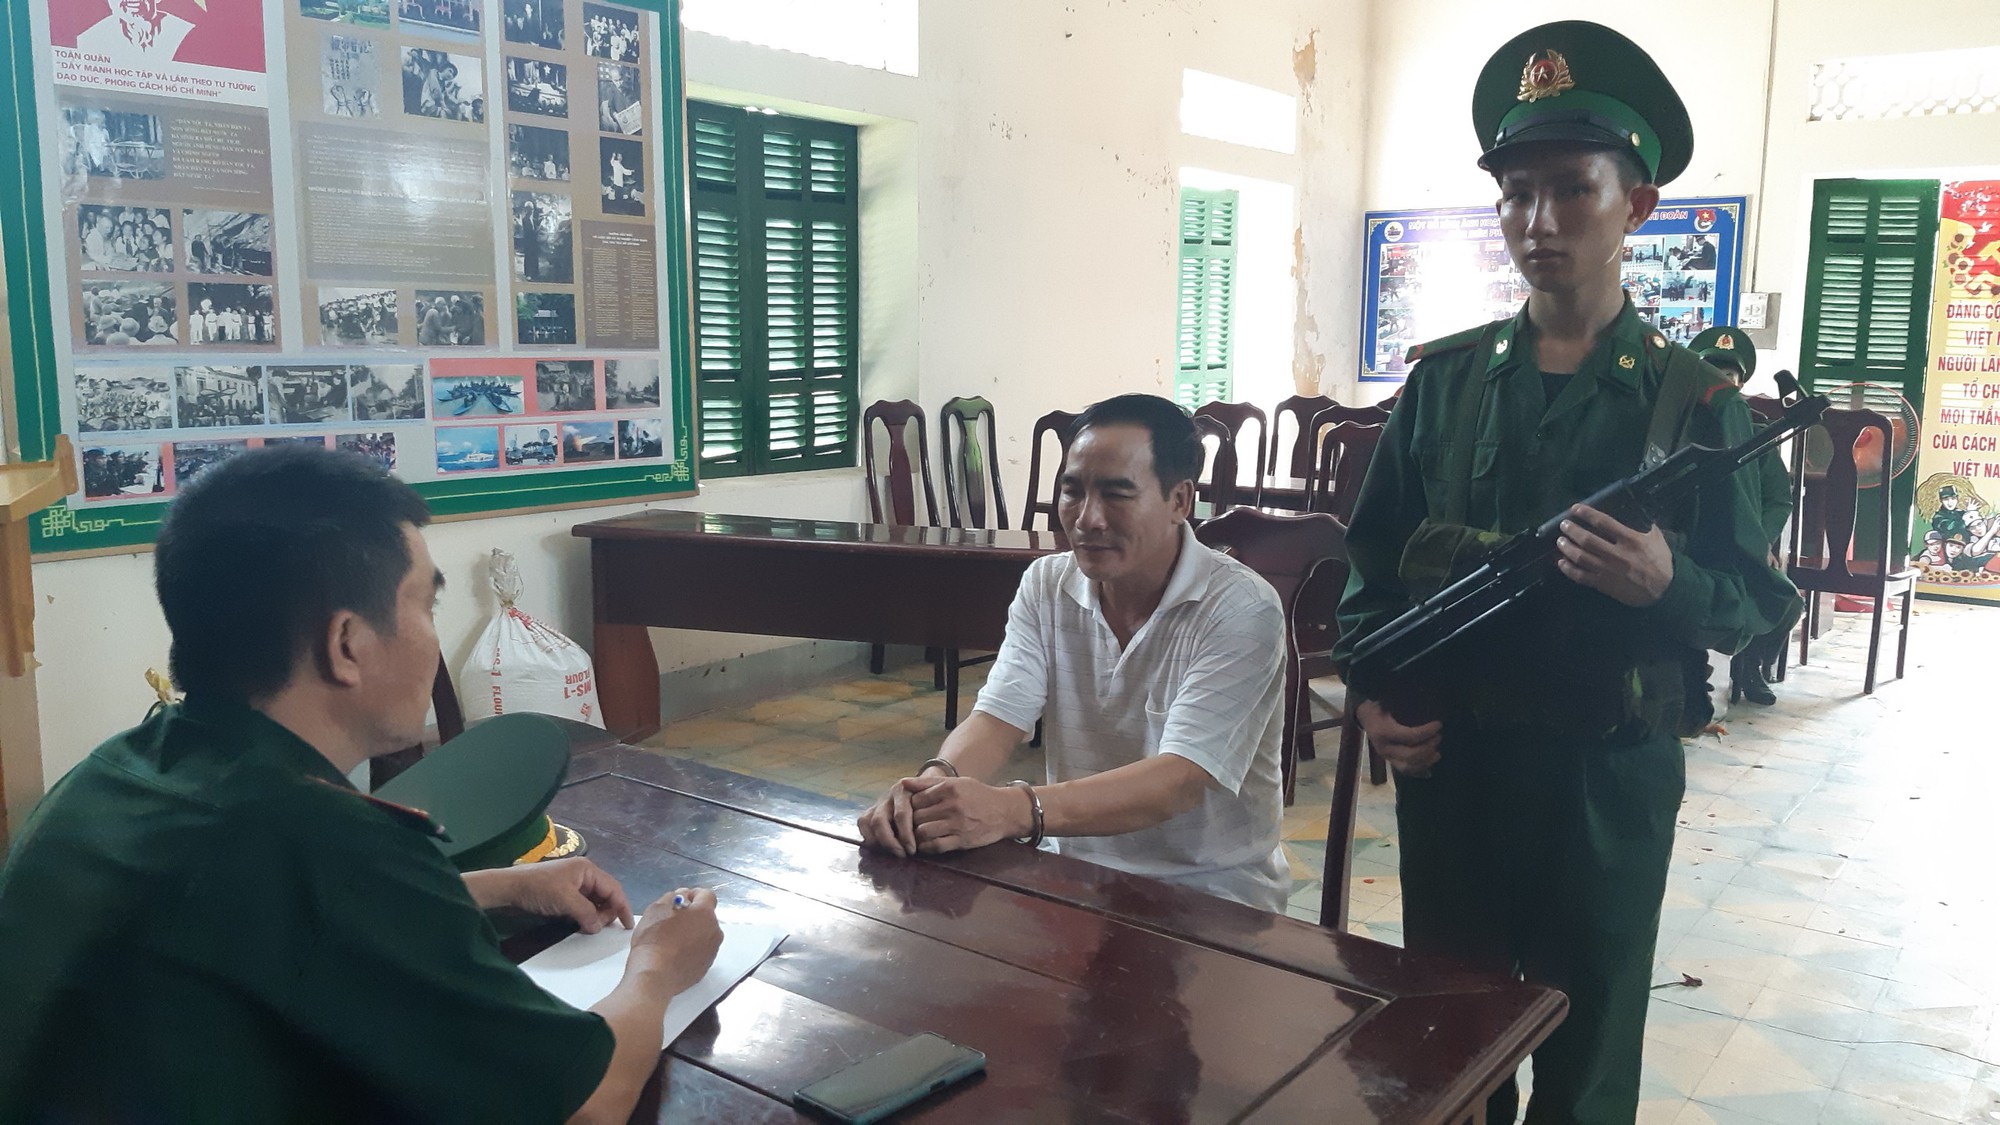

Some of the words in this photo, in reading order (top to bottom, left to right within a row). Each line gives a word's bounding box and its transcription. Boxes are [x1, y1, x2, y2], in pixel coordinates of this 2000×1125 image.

[105, 77, 136, 88] PHONG
[138, 80, 163, 91] CÁCH
[114, 68, 133, 78] HỌC
[155, 72, 168, 81] VÀ
[190, 77, 213, 87] THEO
[1660, 209, 1688, 220] ĐOÀN
[1946, 300, 1981, 319] ĐẢNG
[1965, 327, 1993, 349] VIỆT
[1937, 354, 1977, 372] NGƯỜI
[1963, 377, 1979, 398] TỔ
[1940, 408, 1964, 427] MỌI
[1932, 430, 1957, 450] CỦA
[1962, 432, 1997, 452] CÁCH
[1953, 458, 1980, 480] VIỆT
[565, 667, 591, 685] FLOUR
[564, 679, 592, 700] MS-1
[492, 686, 503, 715] FLOU
